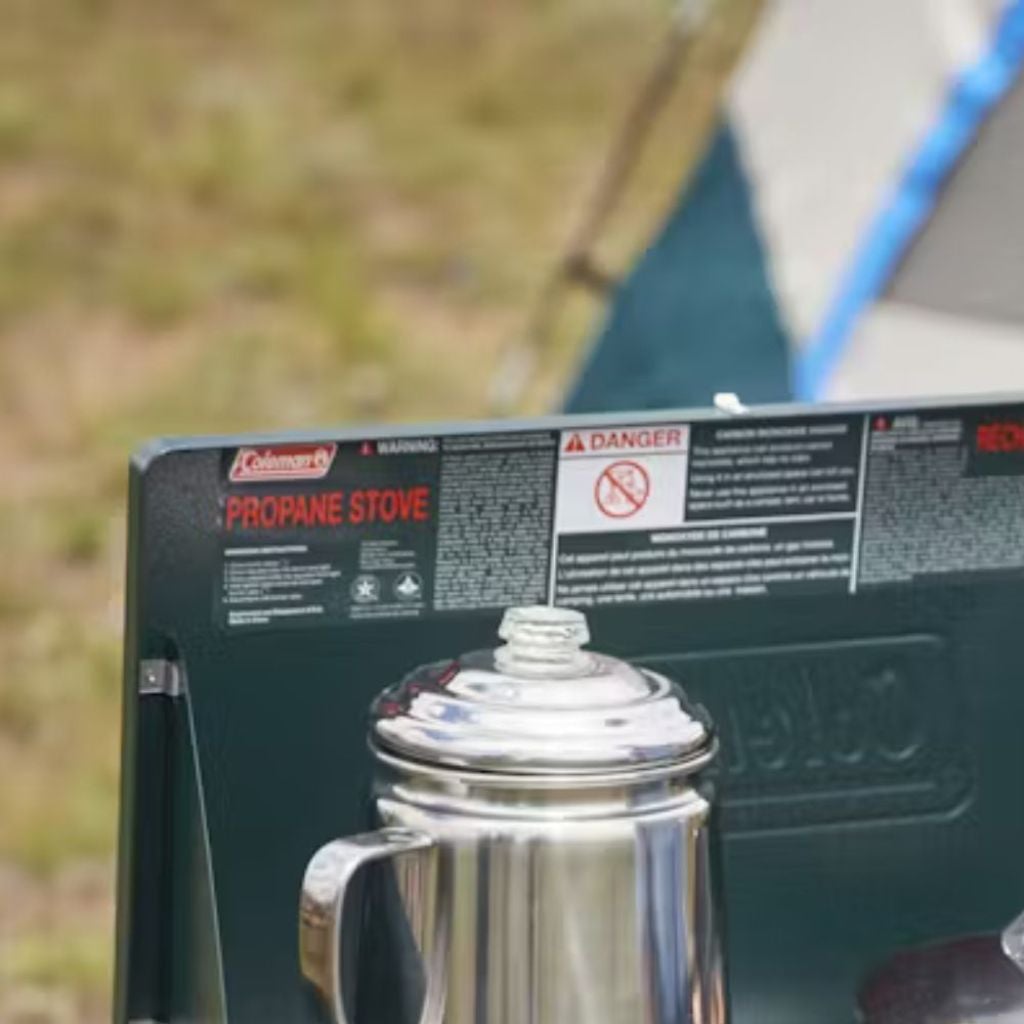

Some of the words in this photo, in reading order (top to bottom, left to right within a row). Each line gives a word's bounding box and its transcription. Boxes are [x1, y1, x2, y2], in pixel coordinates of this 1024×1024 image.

[590, 429, 681, 450] DANGER
[226, 491, 342, 530] PROPANE
[349, 486, 431, 525] STOVE
